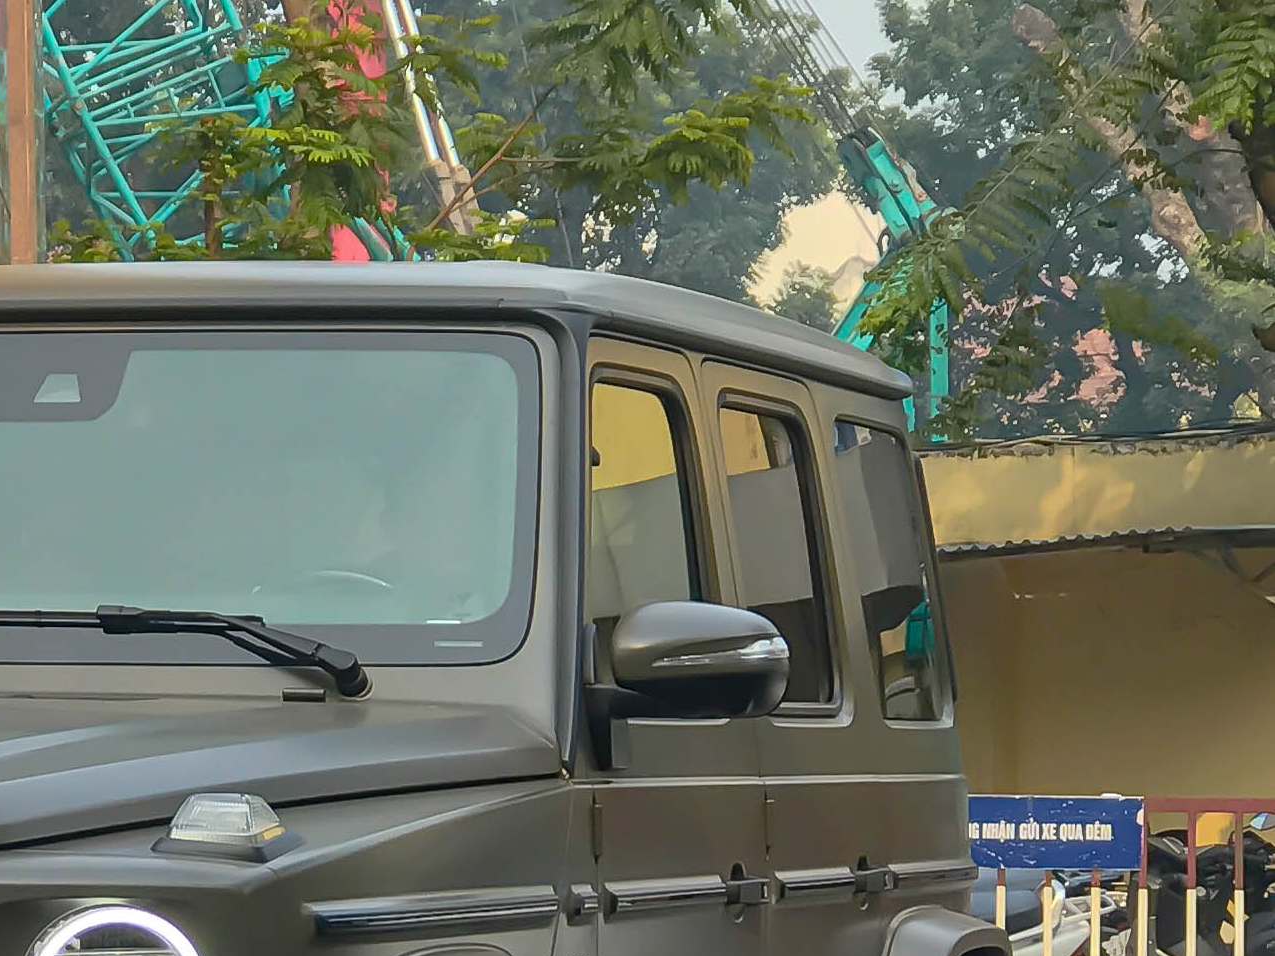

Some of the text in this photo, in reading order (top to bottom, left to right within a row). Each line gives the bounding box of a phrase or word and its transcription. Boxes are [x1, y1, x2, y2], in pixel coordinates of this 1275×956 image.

[982, 820, 1015, 843] NHẬN
[1042, 823, 1057, 840] XE
[1059, 823, 1084, 842] QUA
